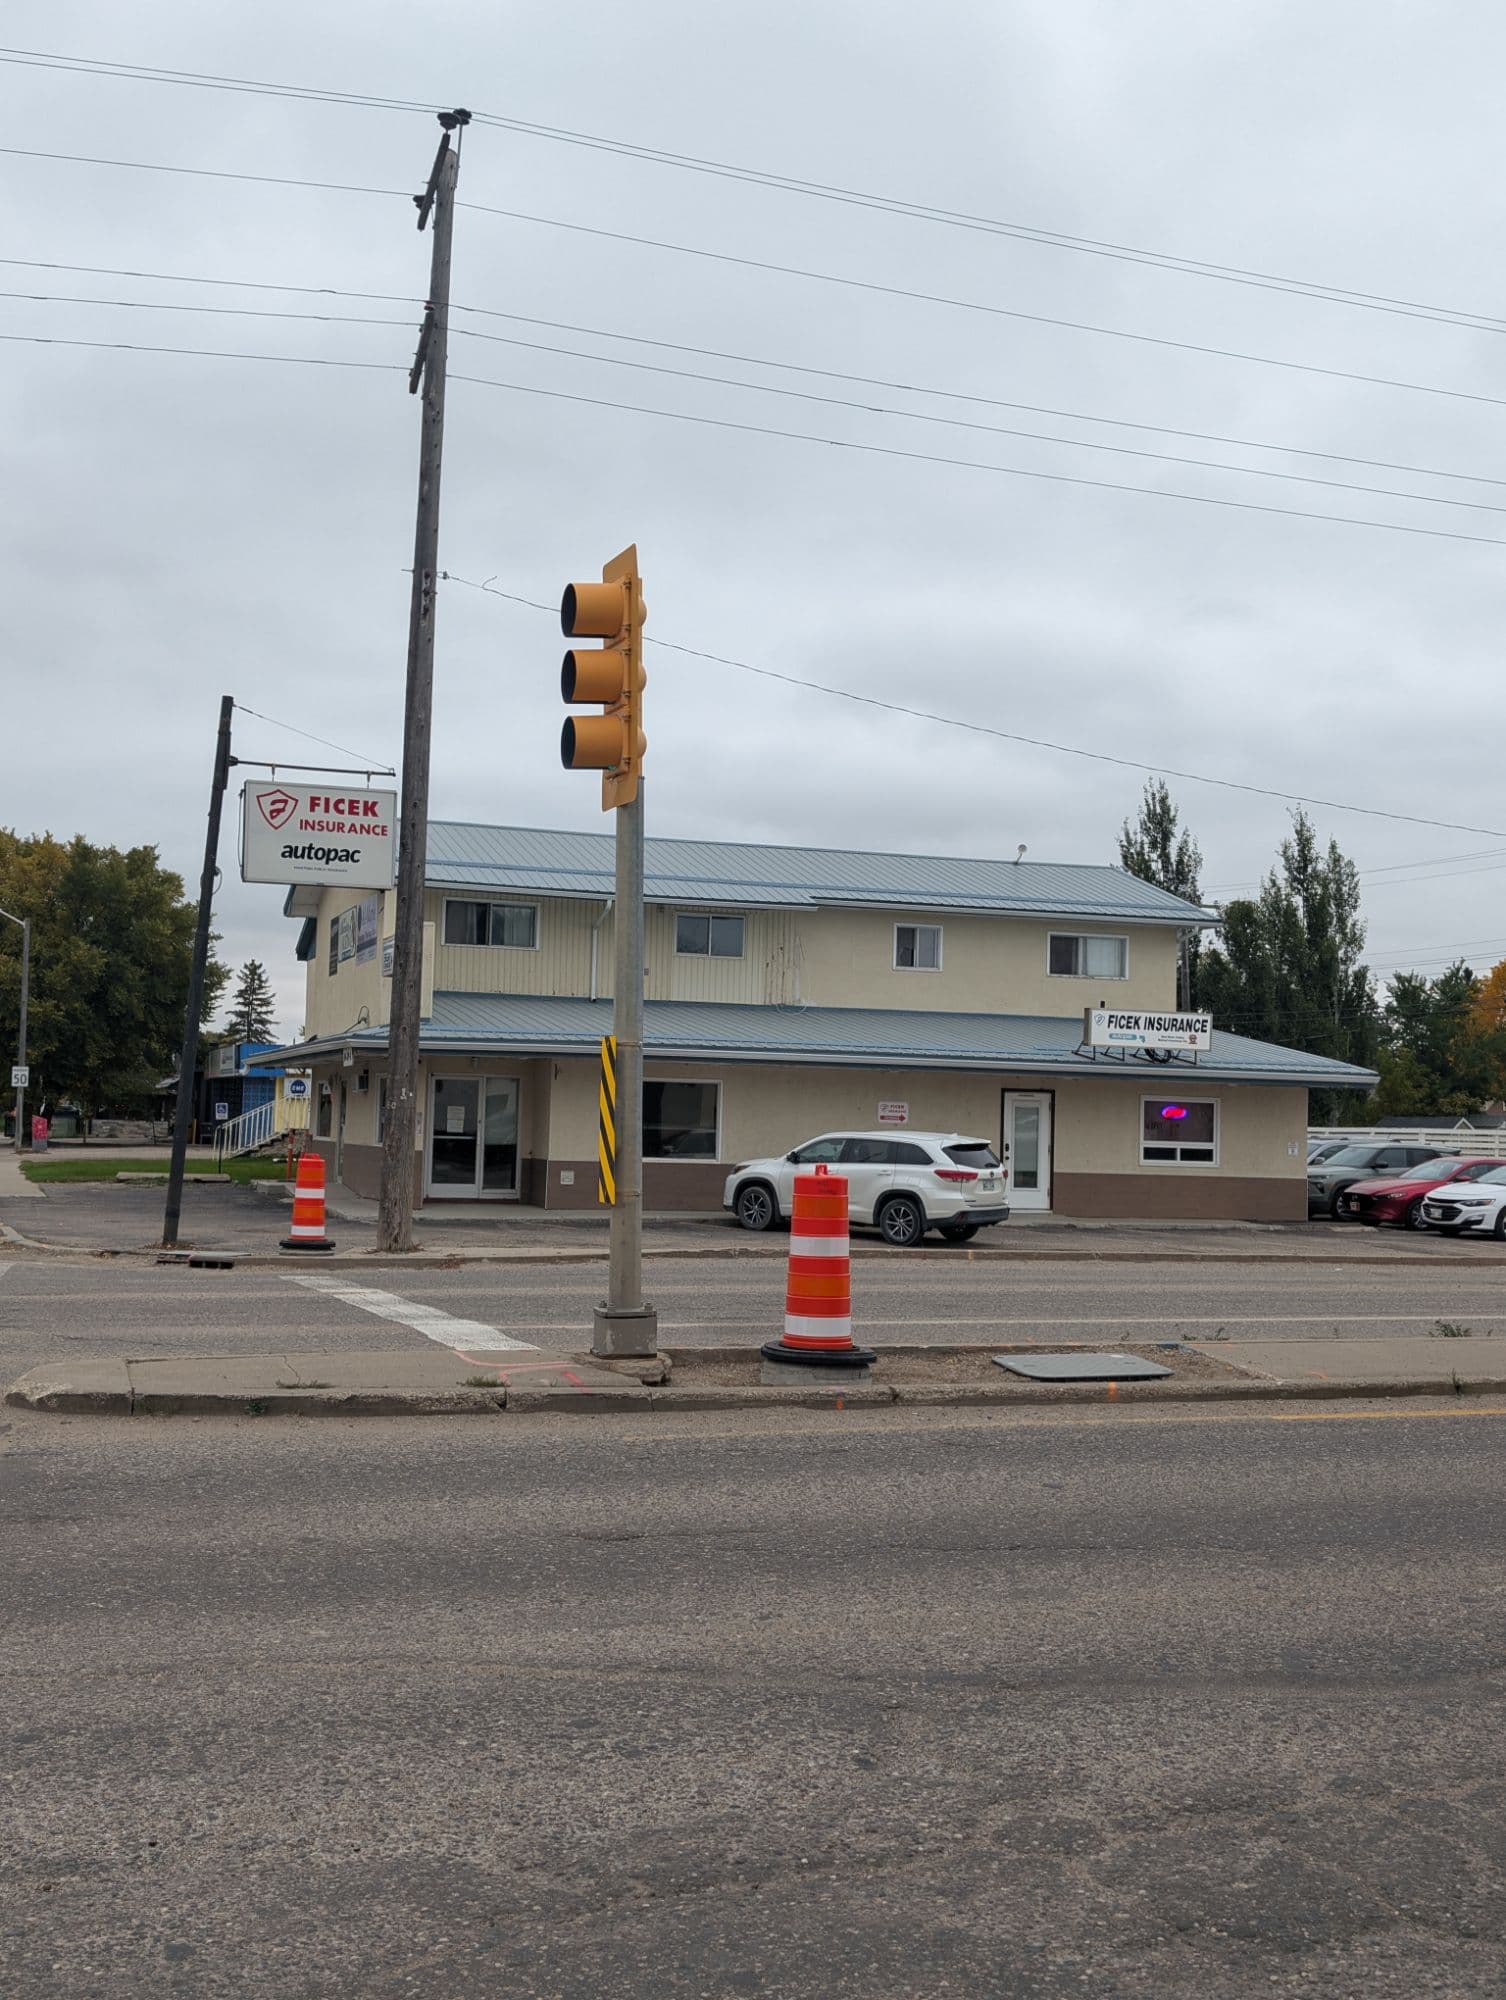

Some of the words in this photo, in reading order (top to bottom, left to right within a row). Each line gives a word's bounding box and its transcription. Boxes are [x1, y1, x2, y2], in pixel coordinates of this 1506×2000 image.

[309, 796, 379, 817] FICEK
[299, 819, 388, 836] INSURANCE
[281, 843, 361, 865] autopac
[1108, 1015, 1142, 1030] FICEK
[1143, 1018, 1209, 1033] INSURANCE
[14, 1073, 27, 1085] 50
